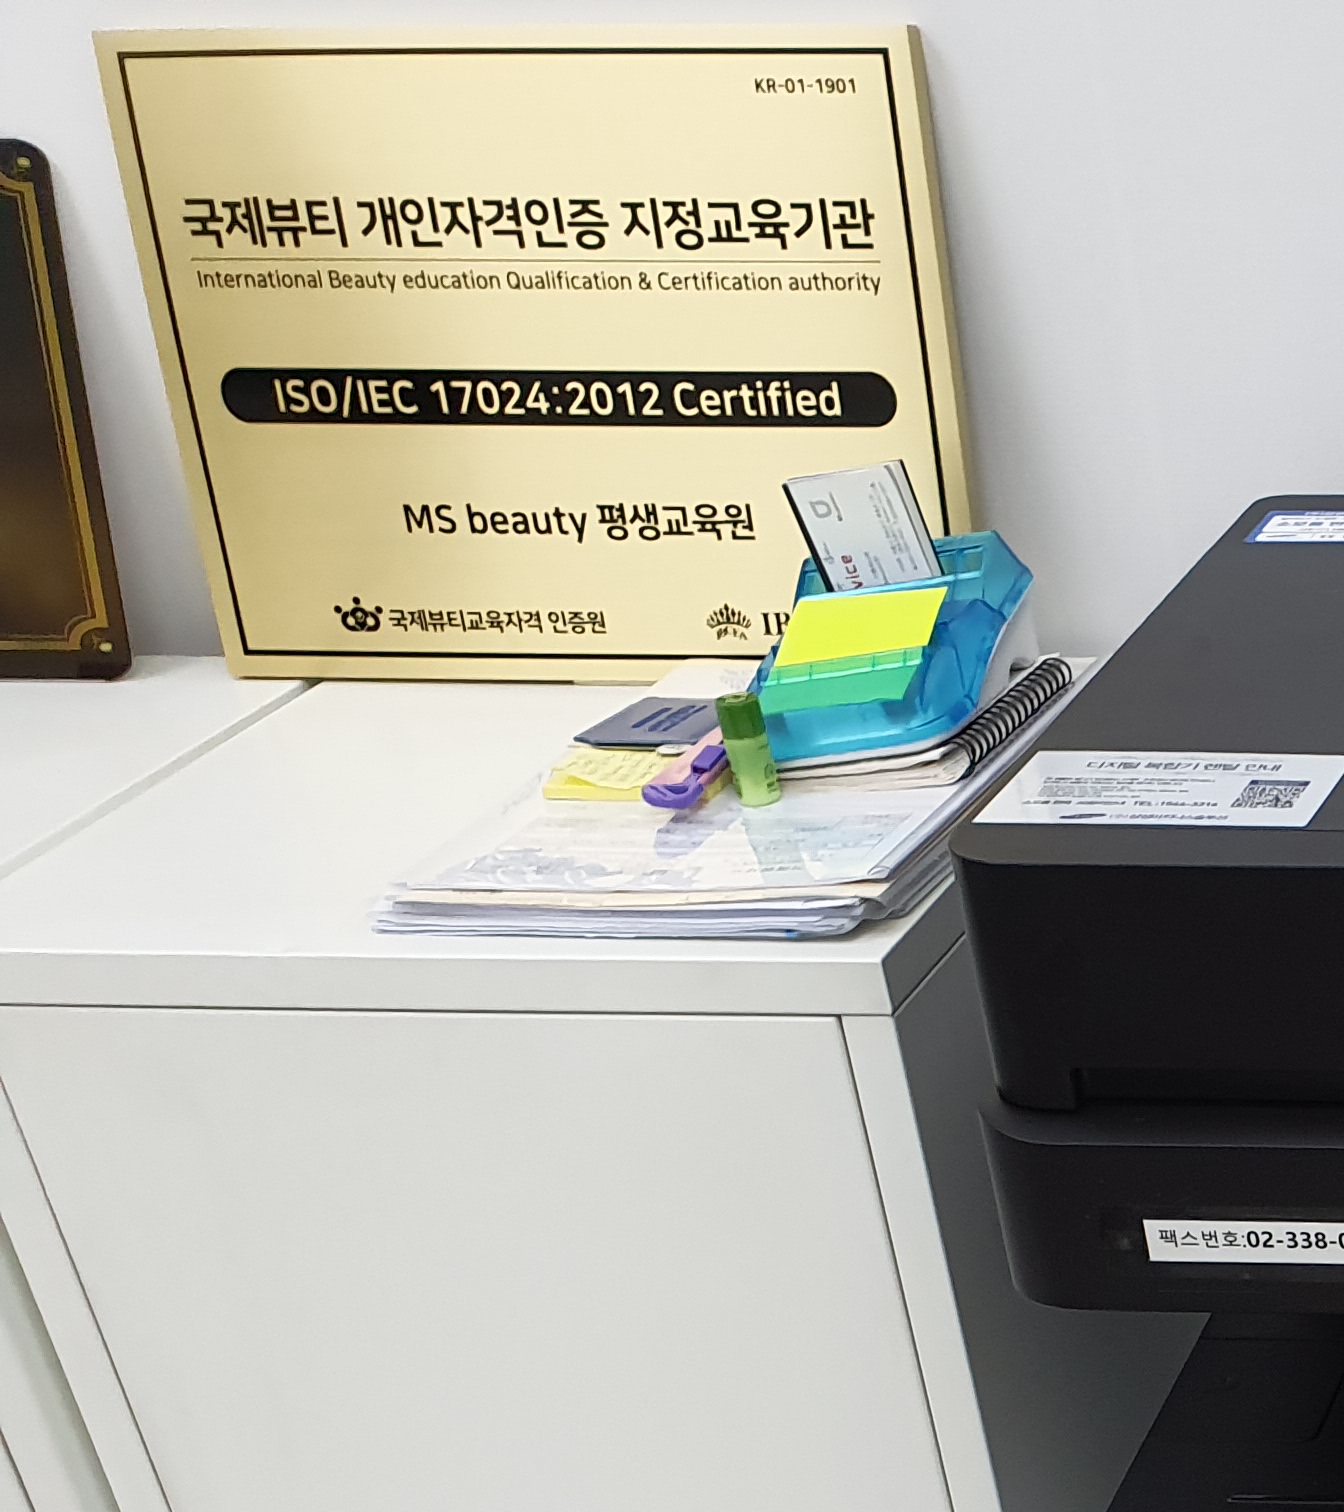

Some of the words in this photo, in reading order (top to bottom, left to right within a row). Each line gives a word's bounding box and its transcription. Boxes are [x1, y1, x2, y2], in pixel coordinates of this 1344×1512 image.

[753, 76, 857, 95] KR-01-1901
[182, 195, 349, 250] 국제뷰티
[356, 196, 610, 251] 개인자격인증
[619, 197, 876, 251] 지정교육기관
[196, 269, 323, 290] International
[327, 269, 397, 294] Beauty
[402, 269, 501, 291] education
[506, 270, 632, 291] Qualification
[638, 271, 652, 291] &
[657, 271, 783, 292] Certification
[788, 271, 882, 296] authority
[273, 376, 419, 419] ISO/IEC
[429, 379, 664, 417] 17024:2012
[673, 380, 843, 418] Certified
[402, 503, 457, 536] MS
[466, 503, 588, 544] beauty
[595, 502, 757, 542] 평생교육원
[388, 608, 544, 635] 국제뷰티교육자격
[547, 609, 608, 635] 인증원
